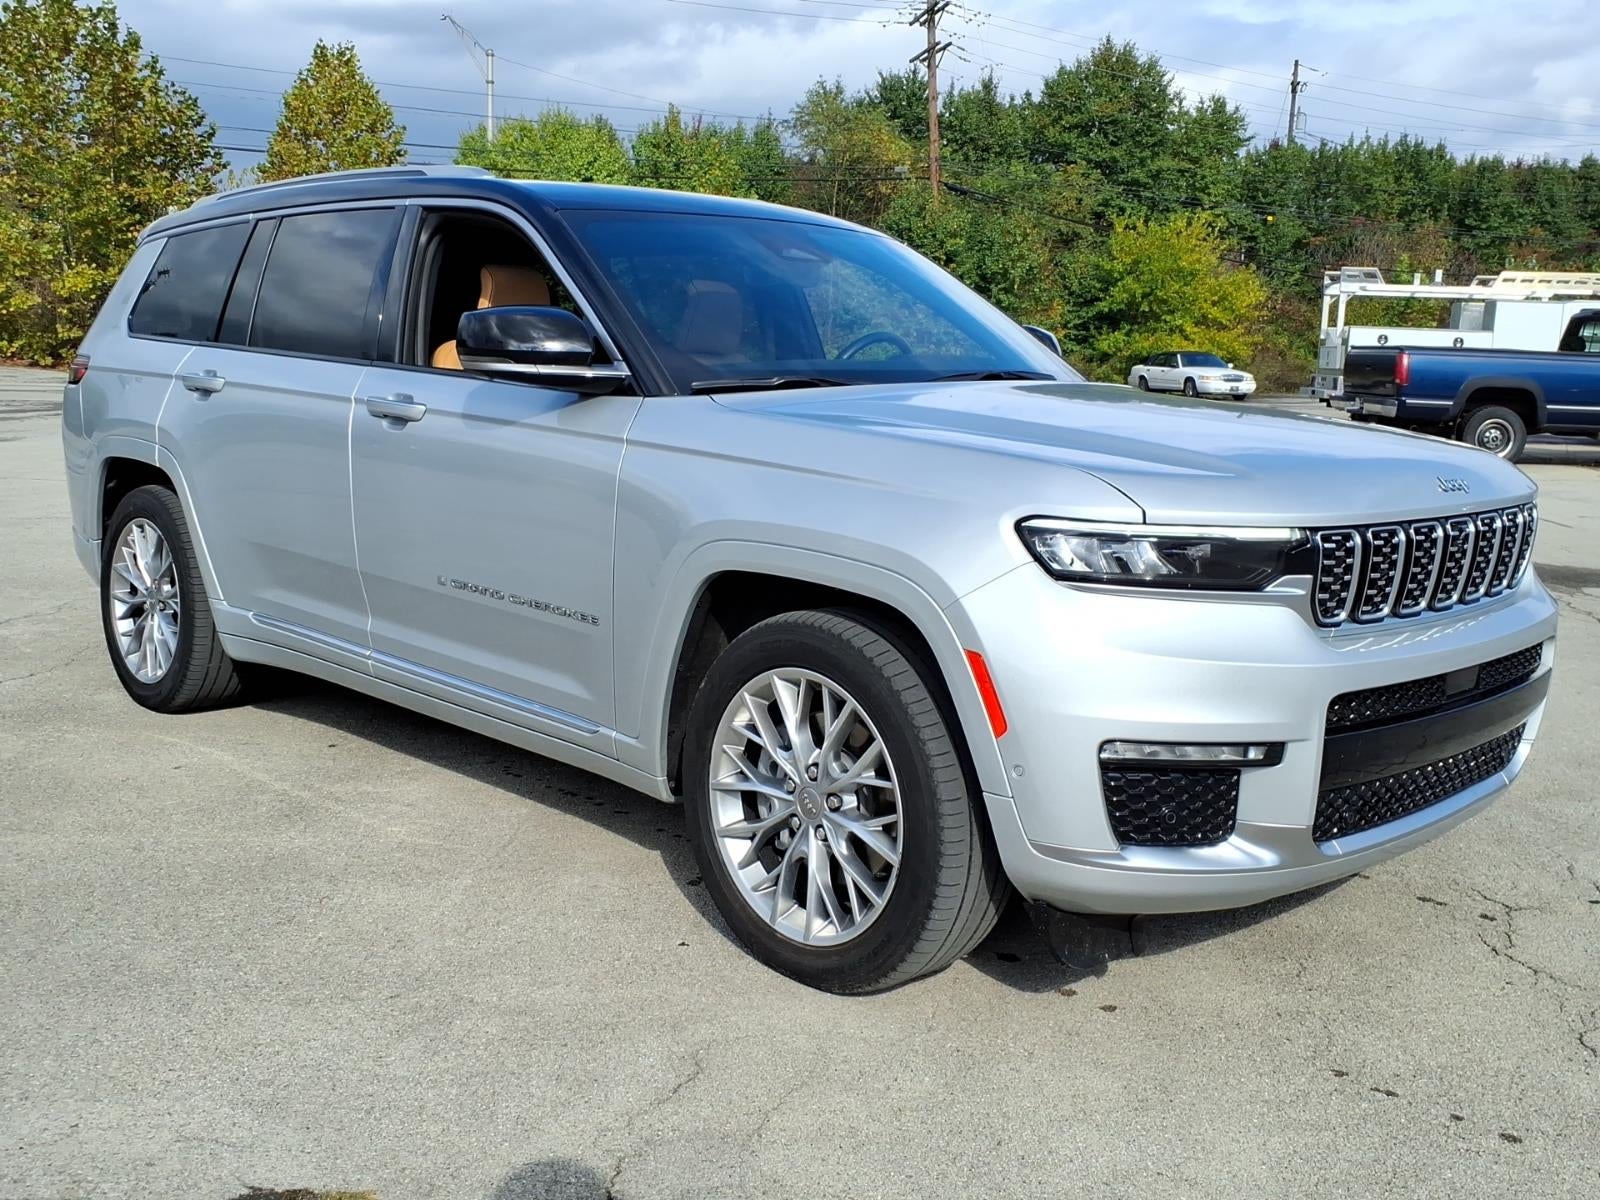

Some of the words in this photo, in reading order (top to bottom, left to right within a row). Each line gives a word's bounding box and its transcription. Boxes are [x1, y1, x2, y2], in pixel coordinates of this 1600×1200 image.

[1436, 475, 1470, 494] Jeep
[450, 579, 505, 601] GRAND
[508, 593, 600, 627] CHEROKEE
